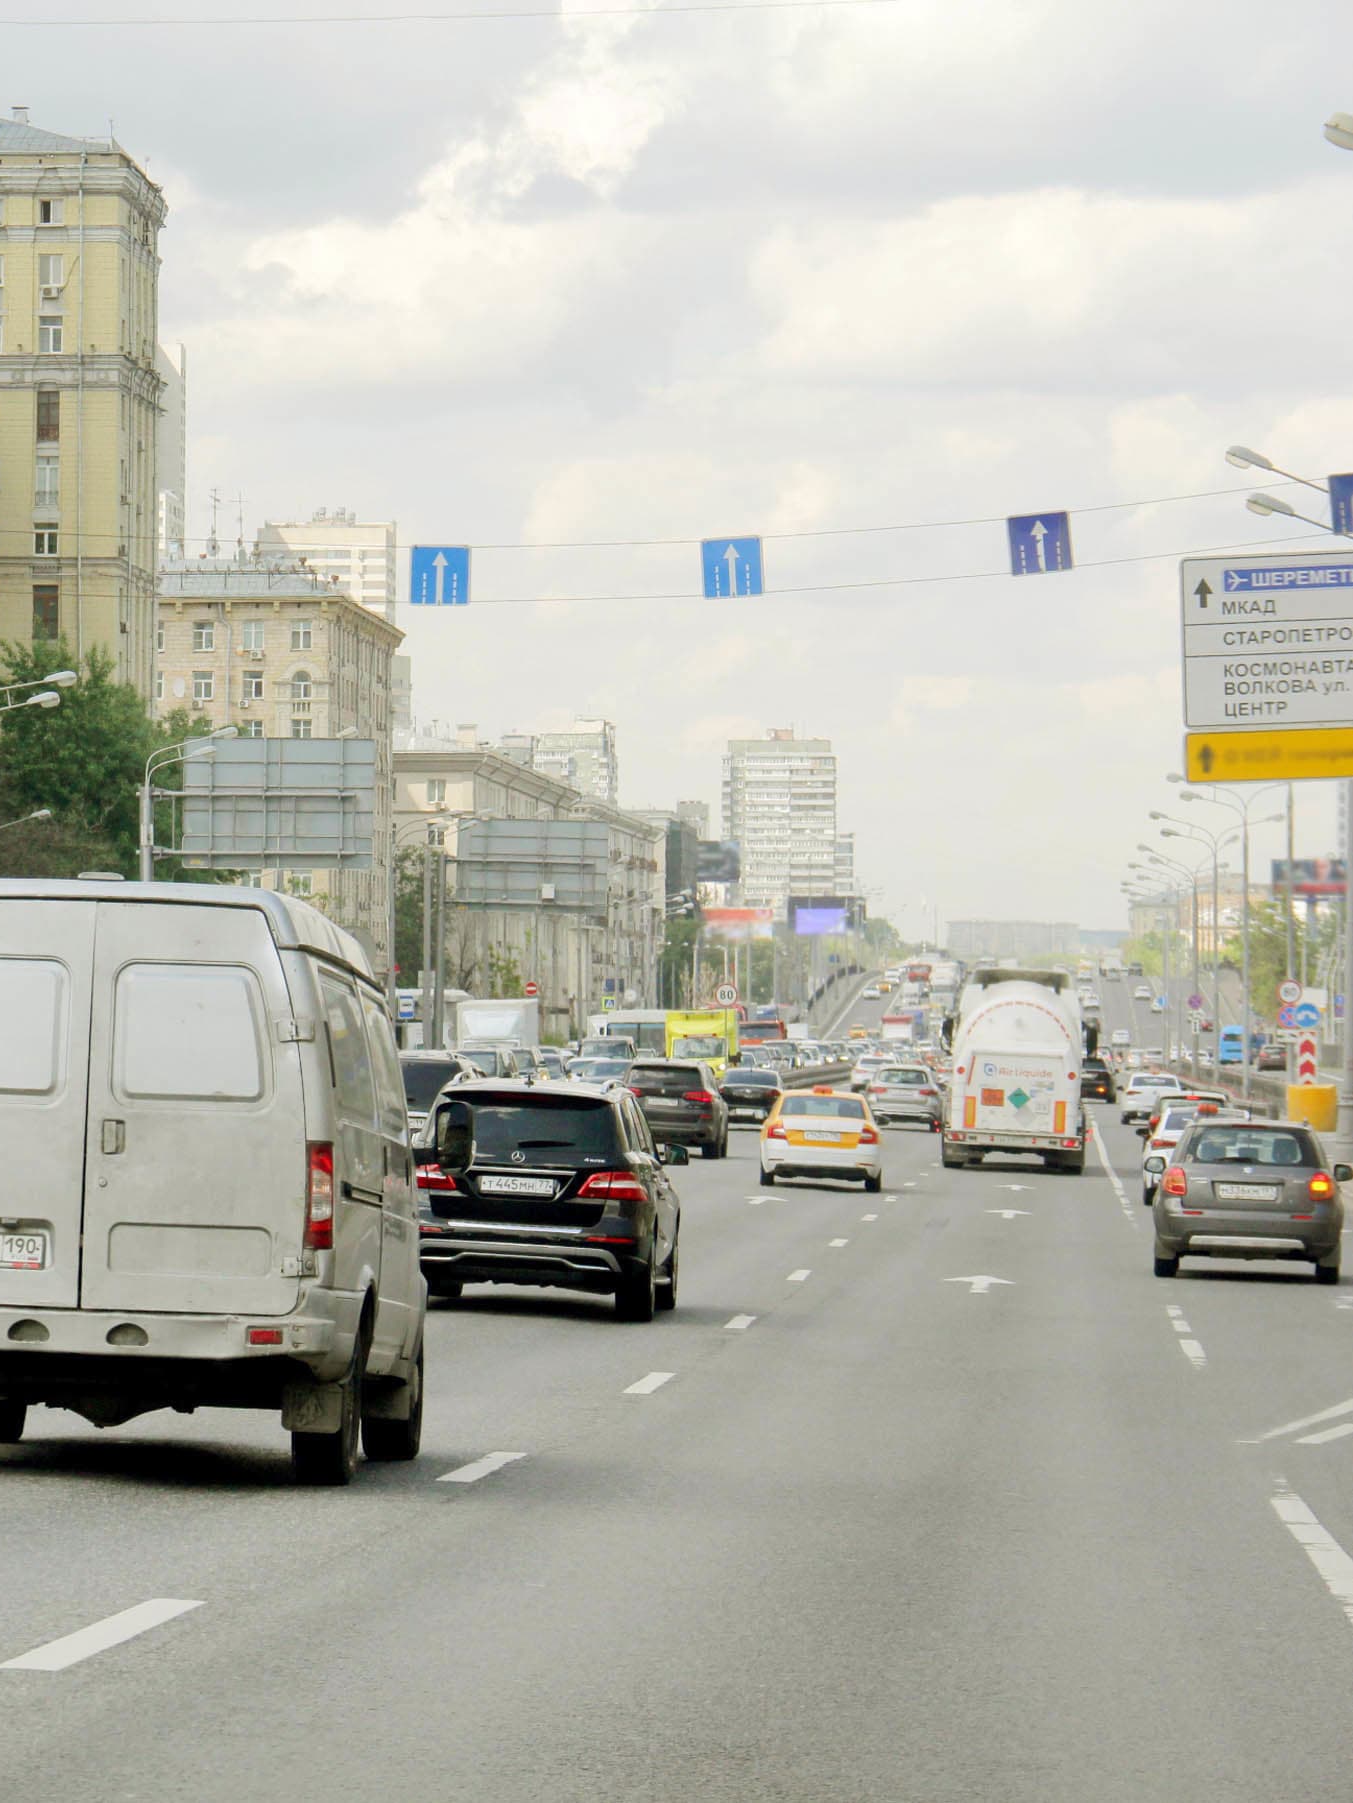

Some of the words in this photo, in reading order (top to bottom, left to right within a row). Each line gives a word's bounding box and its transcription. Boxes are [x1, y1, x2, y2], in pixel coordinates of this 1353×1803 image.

[1251, 569, 1353, 587] ШЕРЕМЕТ
[1221, 599, 1277, 616] МКАД
[1223, 627, 1353, 646] СТАРОПЕТРО
[1224, 660, 1353, 677] КОСМОНАВТА
[1224, 679, 1317, 695] ВОЛКОВА
[1322, 681, 1350, 695] ул.
[1224, 701, 1288, 718] ЦЕНТР
[720, 990, 734, 1001] 80
[5, 1237, 37, 1254] 190
